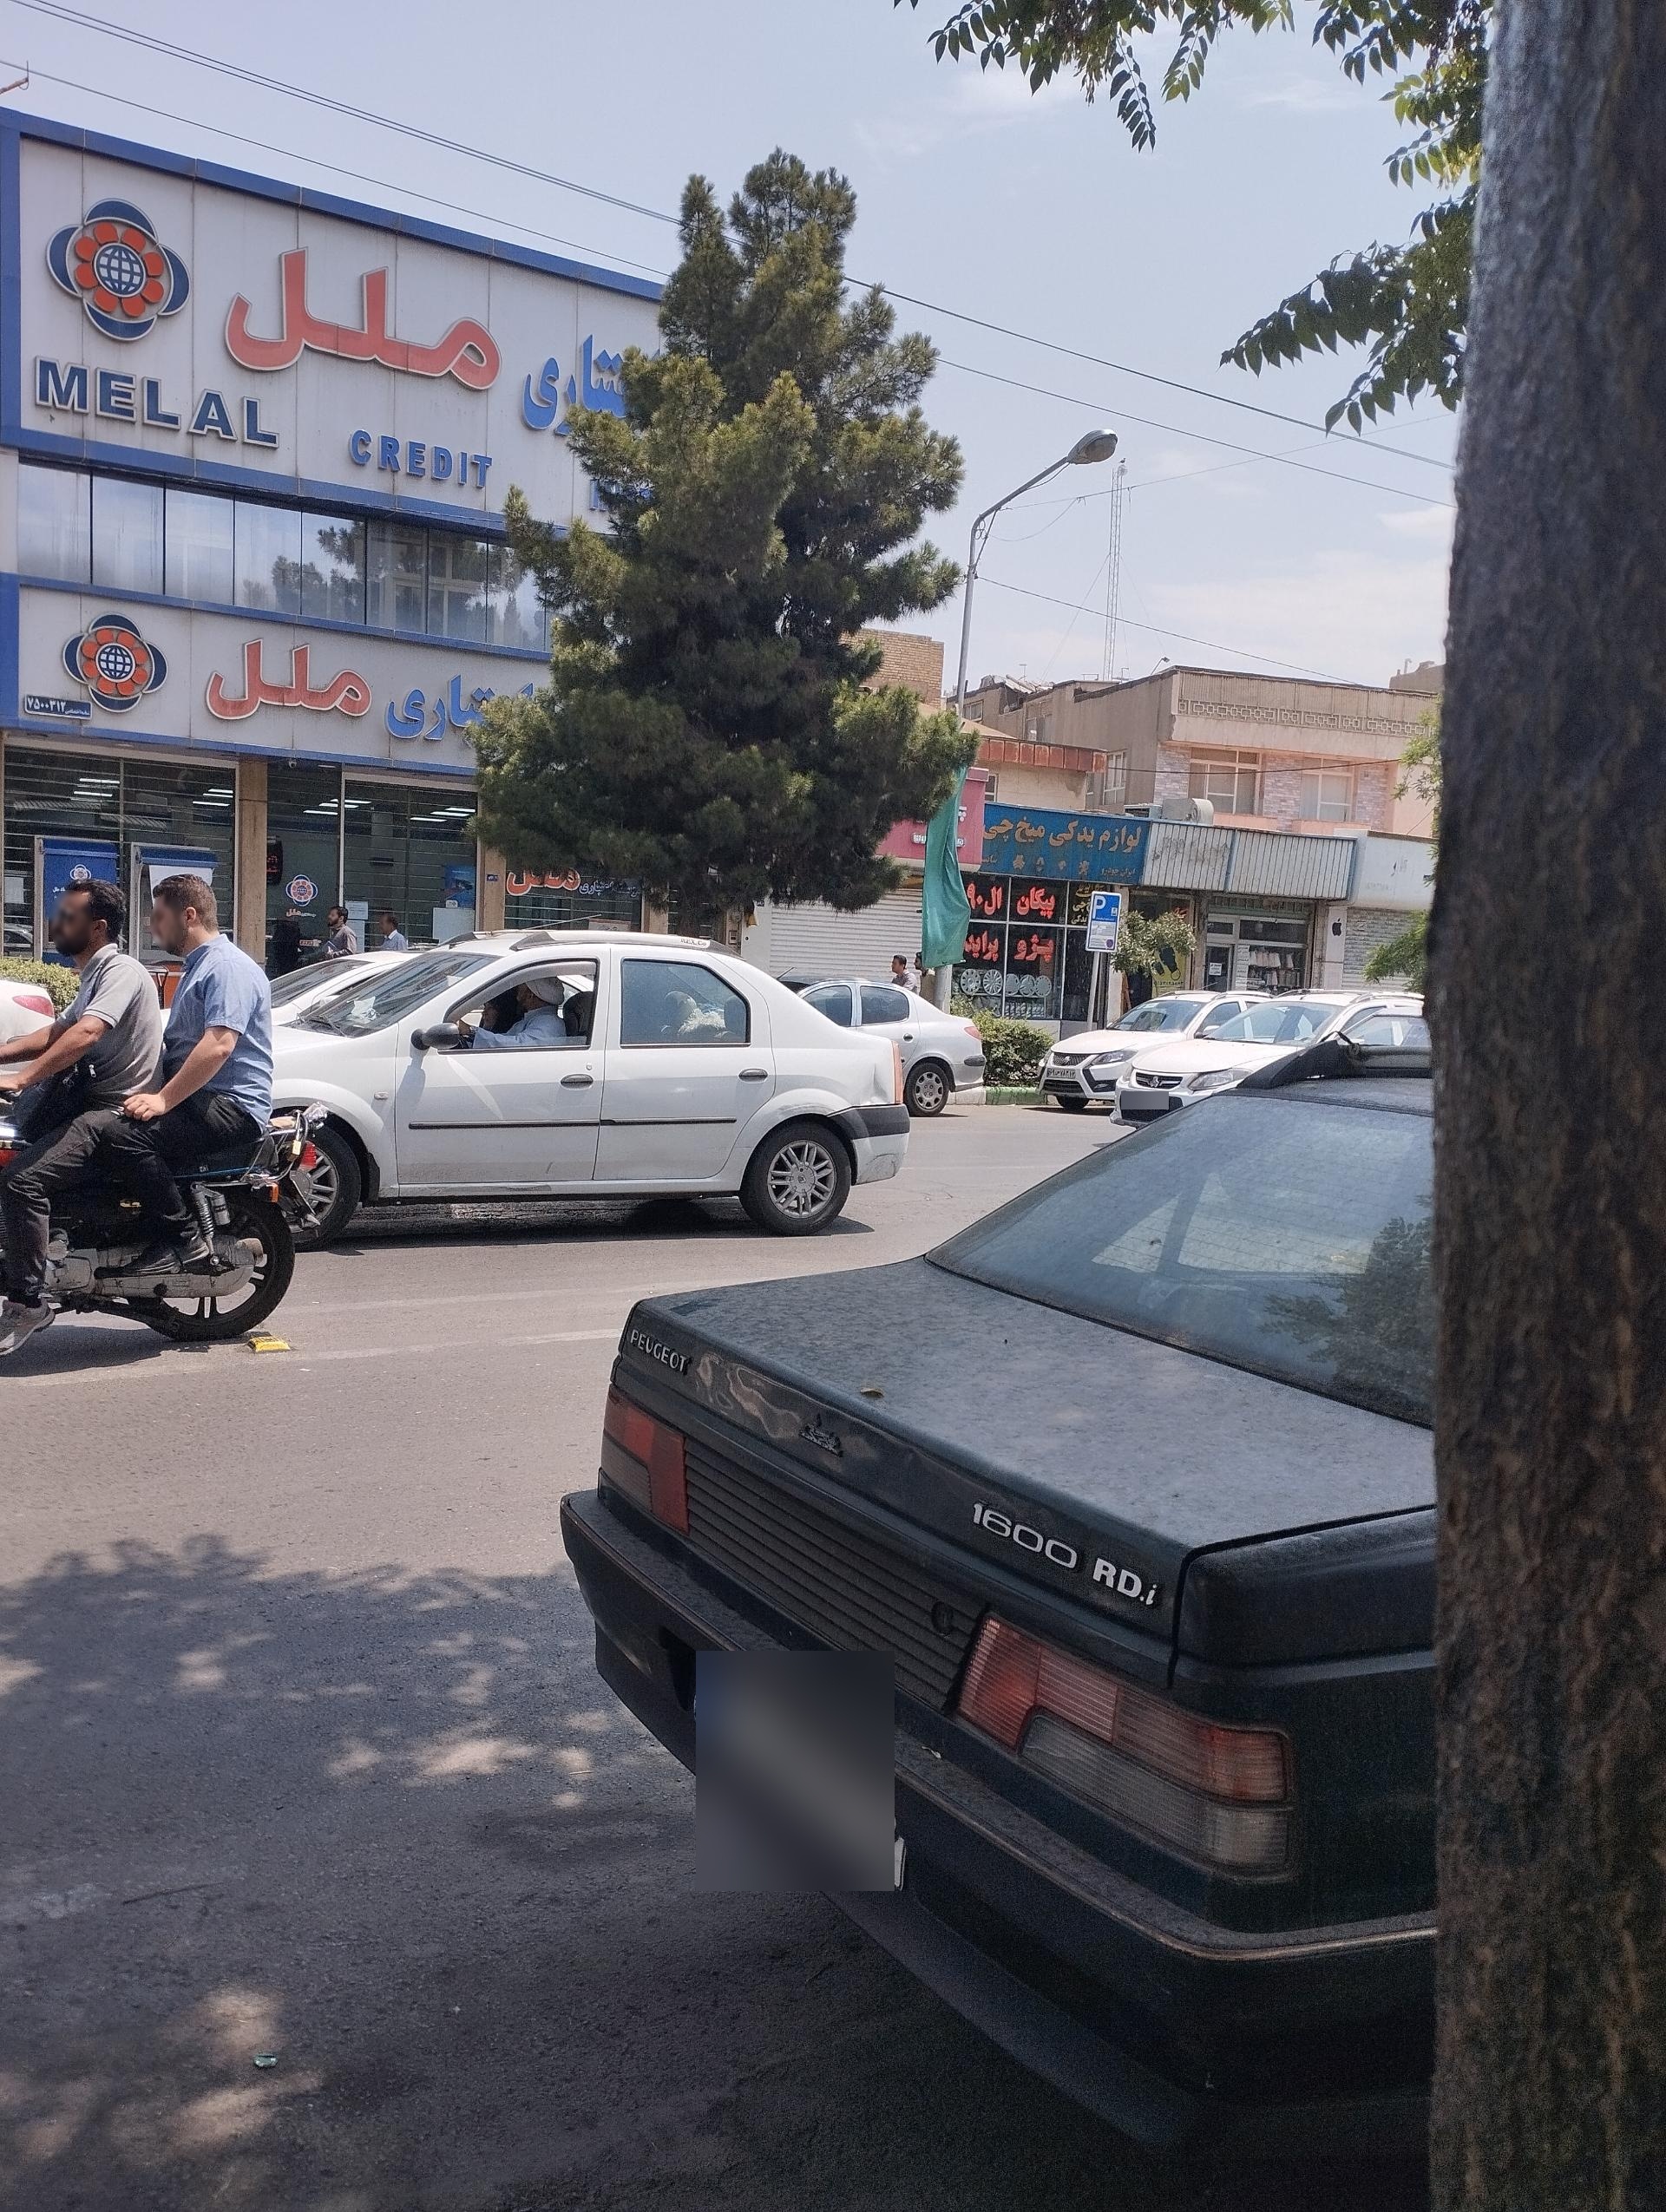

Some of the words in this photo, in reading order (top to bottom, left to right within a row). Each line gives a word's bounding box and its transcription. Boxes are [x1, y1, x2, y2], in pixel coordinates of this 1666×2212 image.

[225, 246, 501, 389] ملل
[35, 356, 279, 448] MELAL
[349, 429, 493, 488] CREDIT
[207, 639, 371, 719] ملل
[1049, 821, 1095, 847] یدکی
[1098, 825, 1142, 853] لوازم
[1017, 887, 1056, 919] پیکان
[1092, 895, 1106, 919] P
[965, 930, 999, 961] پراید
[1013, 933, 1054, 961] پژو
[631, 1329, 688, 1373] PEUGEOT
[973, 1503, 1078, 1569] 1600
